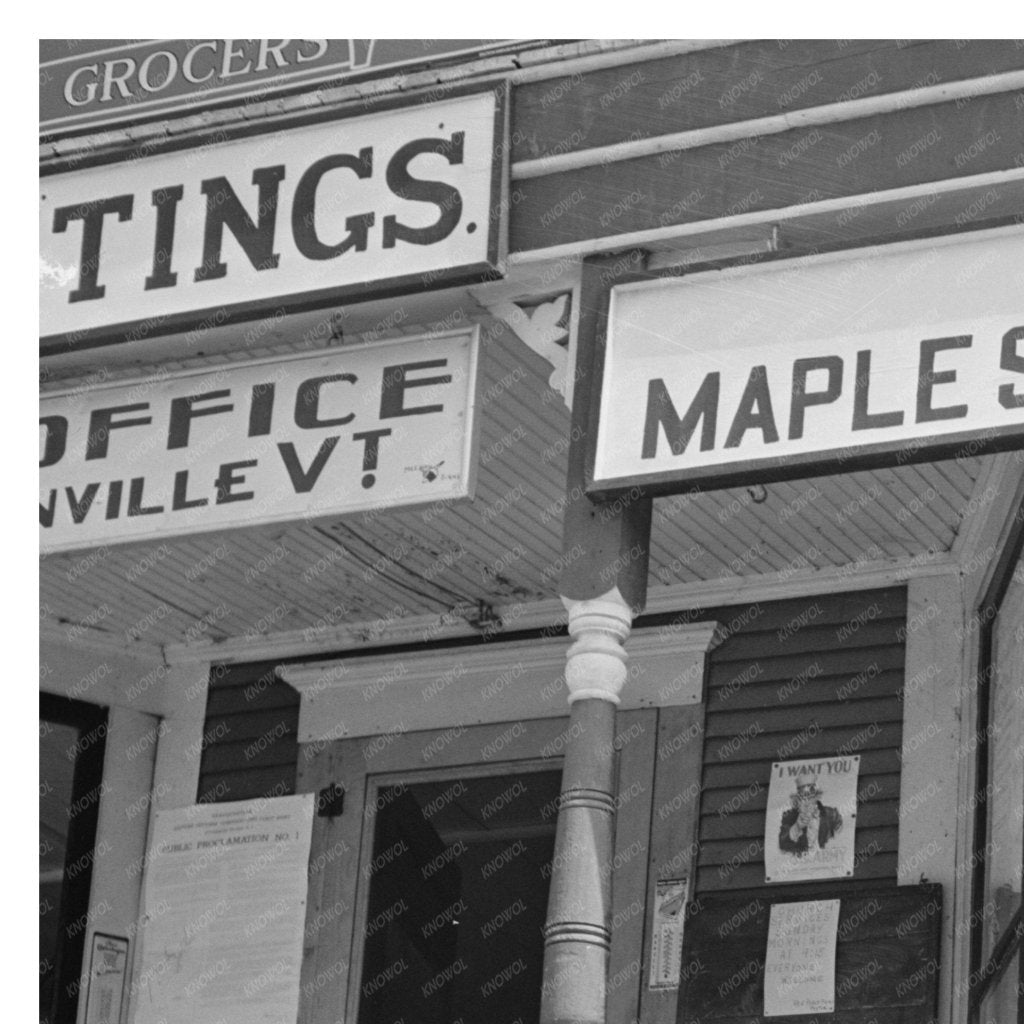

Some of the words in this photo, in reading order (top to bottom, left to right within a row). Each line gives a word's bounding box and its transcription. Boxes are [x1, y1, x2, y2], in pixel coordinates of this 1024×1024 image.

[640, 335, 974, 460] MAPLE
[778, 767, 784, 778] I
[787, 762, 825, 777] WANT
[825, 759, 852, 774] YOU
[196, 833, 270, 849] PROCLAMATION
